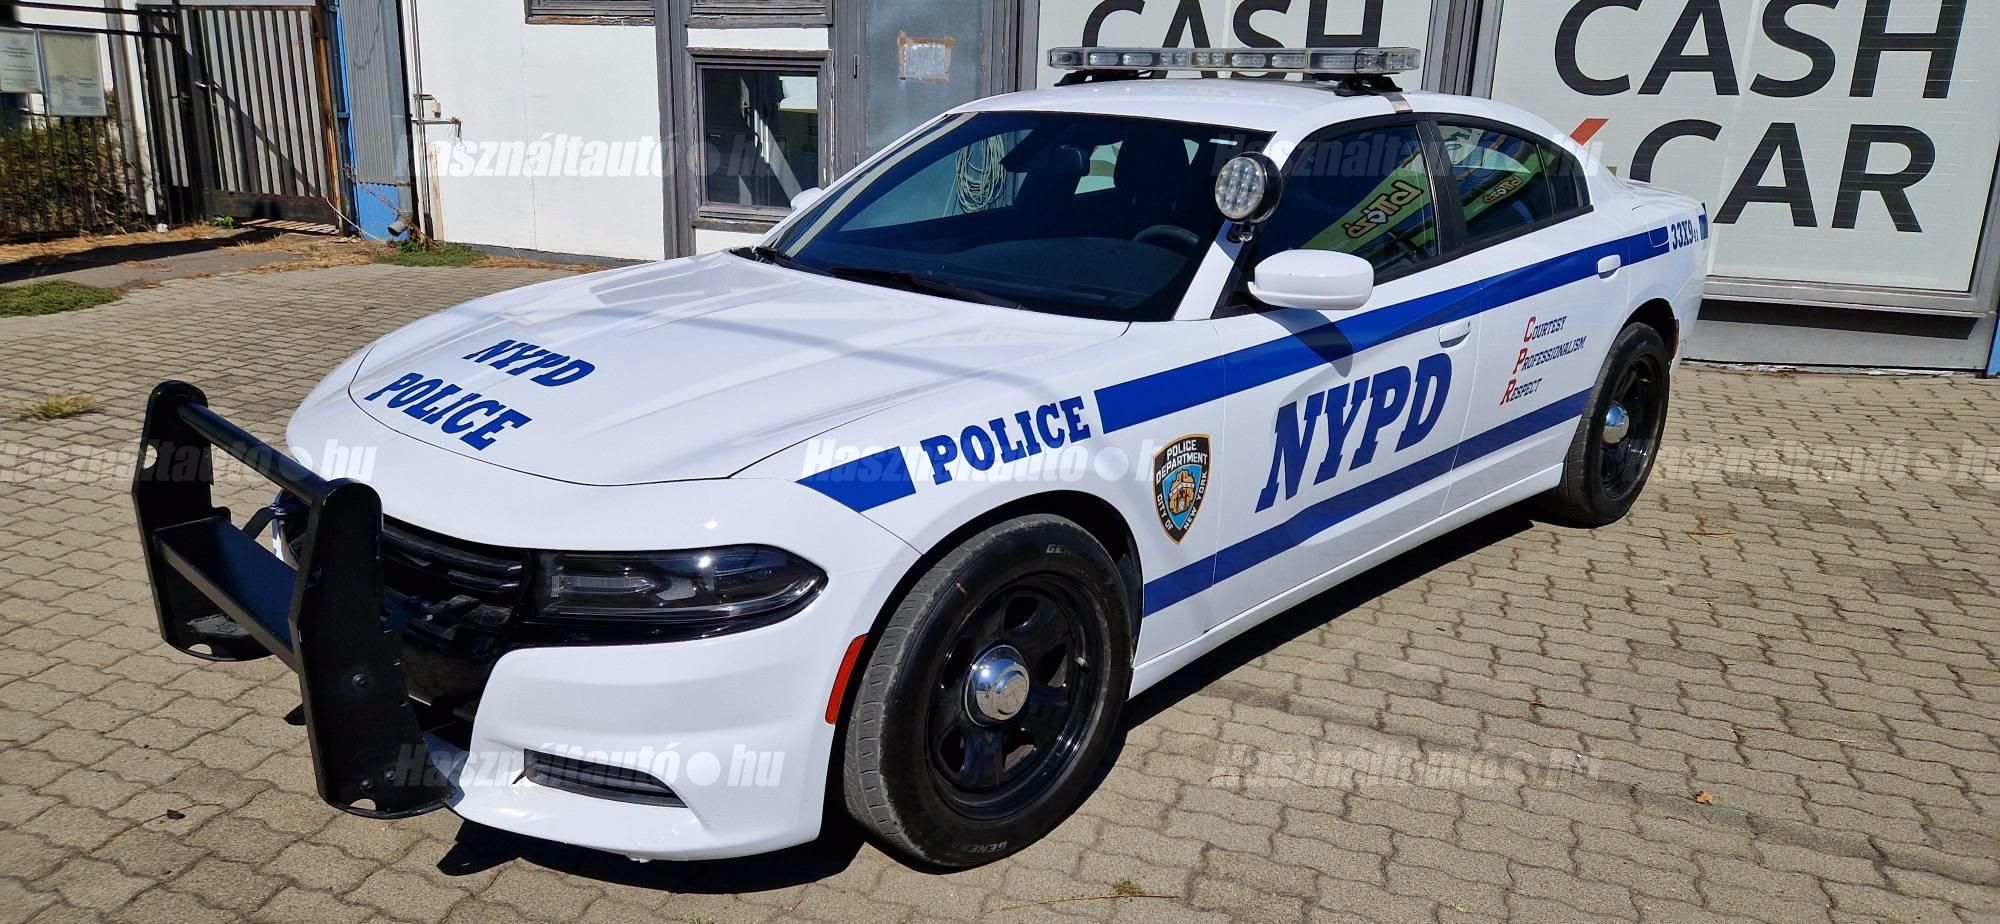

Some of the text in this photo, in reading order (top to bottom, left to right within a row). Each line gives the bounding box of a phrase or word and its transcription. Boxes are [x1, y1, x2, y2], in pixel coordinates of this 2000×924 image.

[1082, 0, 1384, 80] CASH
[1554, 0, 1968, 98] CASH
[1629, 119, 1936, 233] CAR
[1513, 336, 1587, 374] PROFESSIONALISM
[1524, 316, 1567, 342] COURTESY
[462, 339, 595, 387] NYPD
[1500, 378, 1543, 406] RESPECT
[364, 372, 532, 451] POLICE
[920, 396, 1091, 485] POLICE
[1255, 353, 1452, 513] NYPD
[1156, 452, 1208, 485] DEPARTMENT
[1166, 439, 1197, 460] POLICE
[1157, 471, 1208, 531] CITY OF NEW YORK
